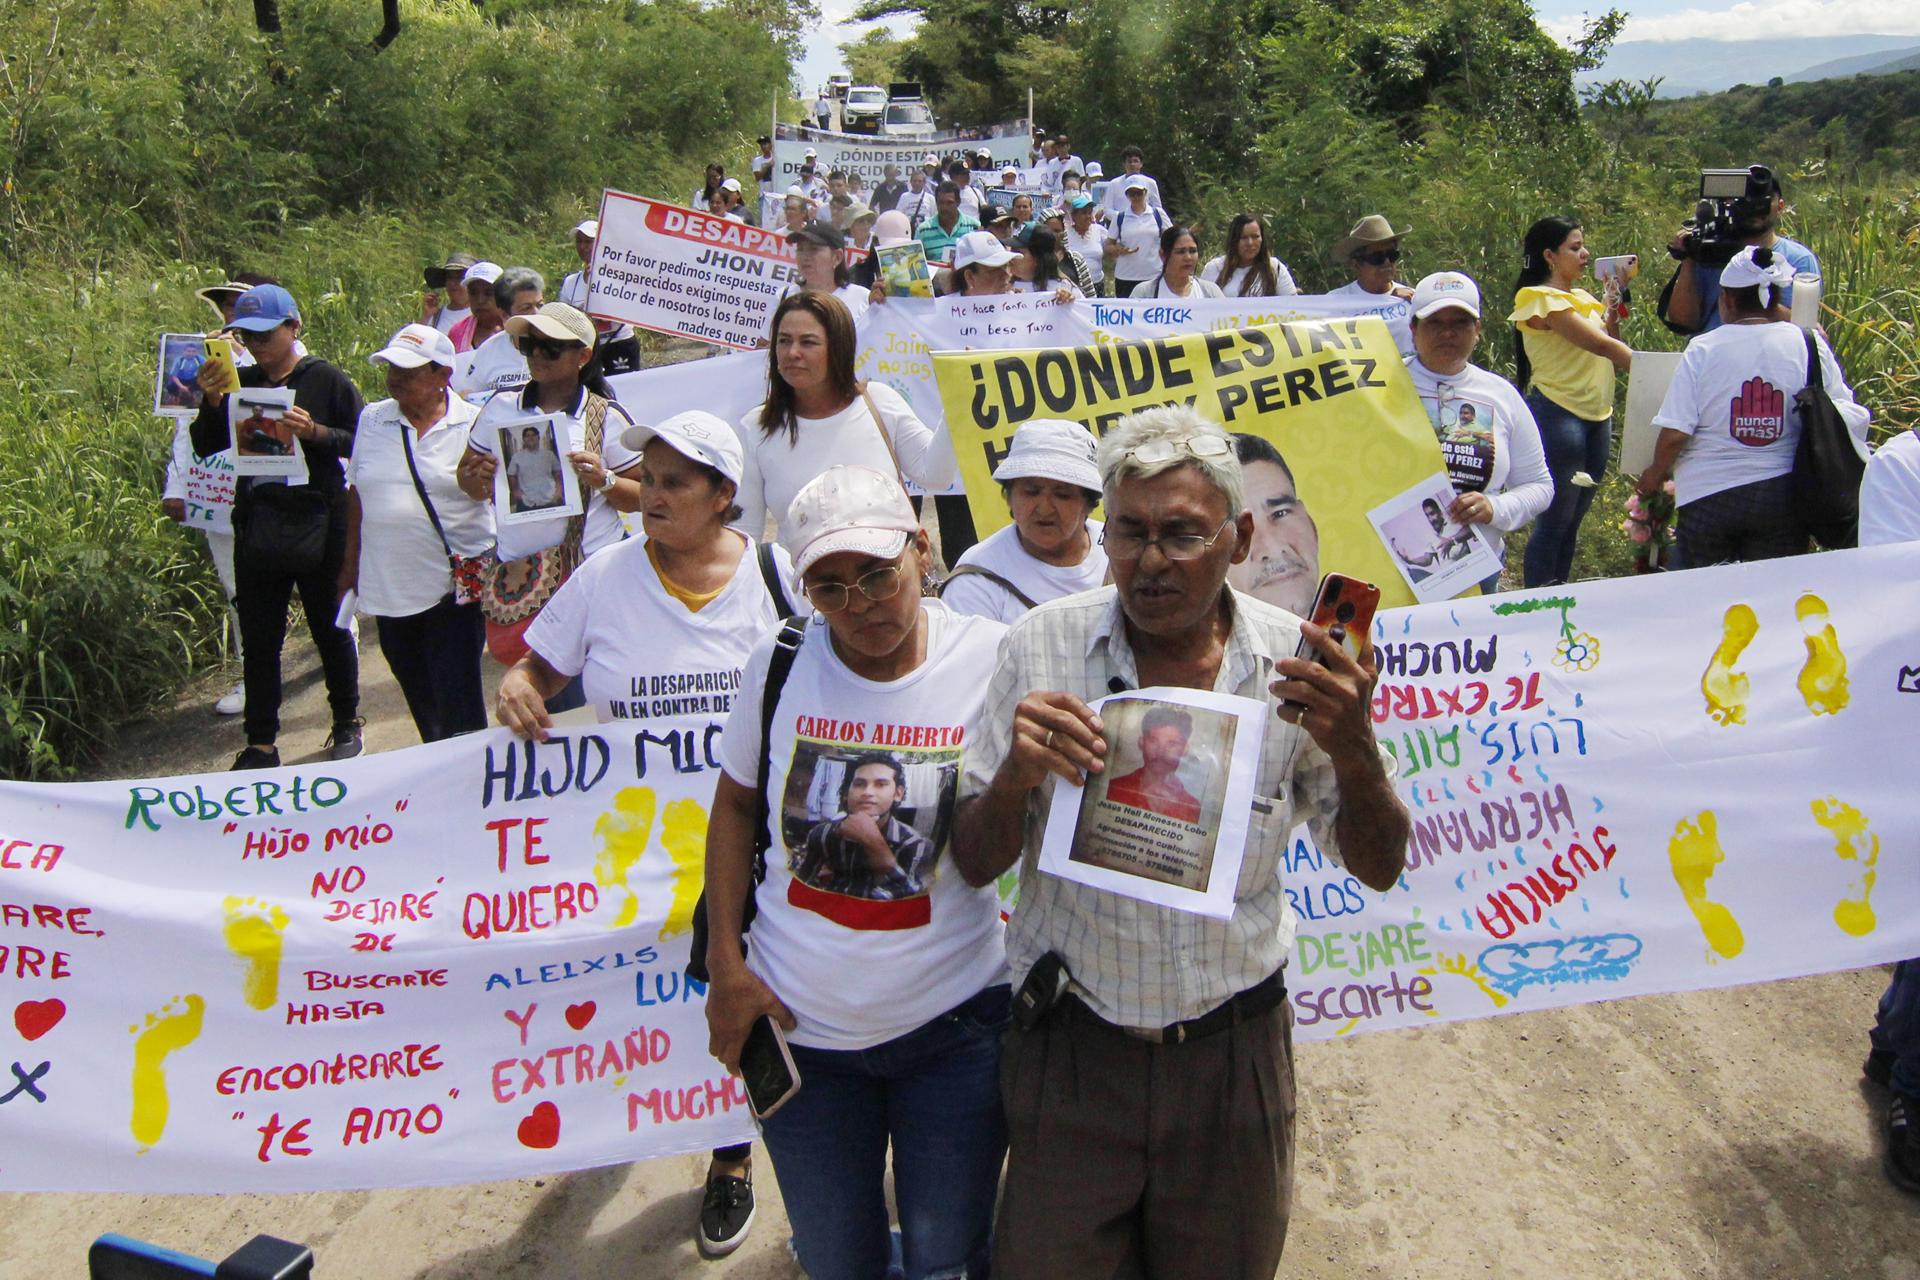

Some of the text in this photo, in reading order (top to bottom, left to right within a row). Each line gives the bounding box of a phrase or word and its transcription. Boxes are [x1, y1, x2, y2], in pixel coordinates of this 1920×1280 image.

[602, 246, 777, 296] Por favor pedimos respuestas
[696, 249, 765, 276] JHON
[591, 280, 601, 294] el
[603, 283, 637, 301] dolor
[640, 291, 655, 306] de
[658, 297, 710, 318] nosotros
[713, 307, 731, 322] los
[598, 263, 767, 312] desaparecidos exigimos que
[988, 324, 1017, 335] beso
[1143, 306, 1193, 325] ERICK
[677, 321, 721, 339] madres
[725, 332, 747, 346] que
[970, 333, 1193, 429] ¿DONDE
[1216, 358, 1387, 421] PEREZ
[1735, 416, 1775, 426] nunca
[1454, 444, 1475, 456] está
[1456, 454, 1484, 469] PEREZ
[188, 503, 214, 520] TE
[631, 676, 647, 698] LA
[1501, 672, 1544, 712] TE
[610, 695, 730, 719] VA EN CONTRA DE
[796, 715, 965, 748] CARLOS ALBERTO
[483, 734, 611, 809] HIJO
[1114, 816, 1184, 841] DESAPARECIDO
[1184, 824, 1207, 837] Lobo
[485, 817, 551, 874] TE
[311, 866, 365, 898] NO
[1476, 825, 1617, 940] JUSTICIA
[462, 882, 599, 940] QUIERO
[286, 1001, 385, 1025] HASTA
[504, 1003, 538, 1046] Y
[491, 1025, 671, 1103] EXTRAÑO
